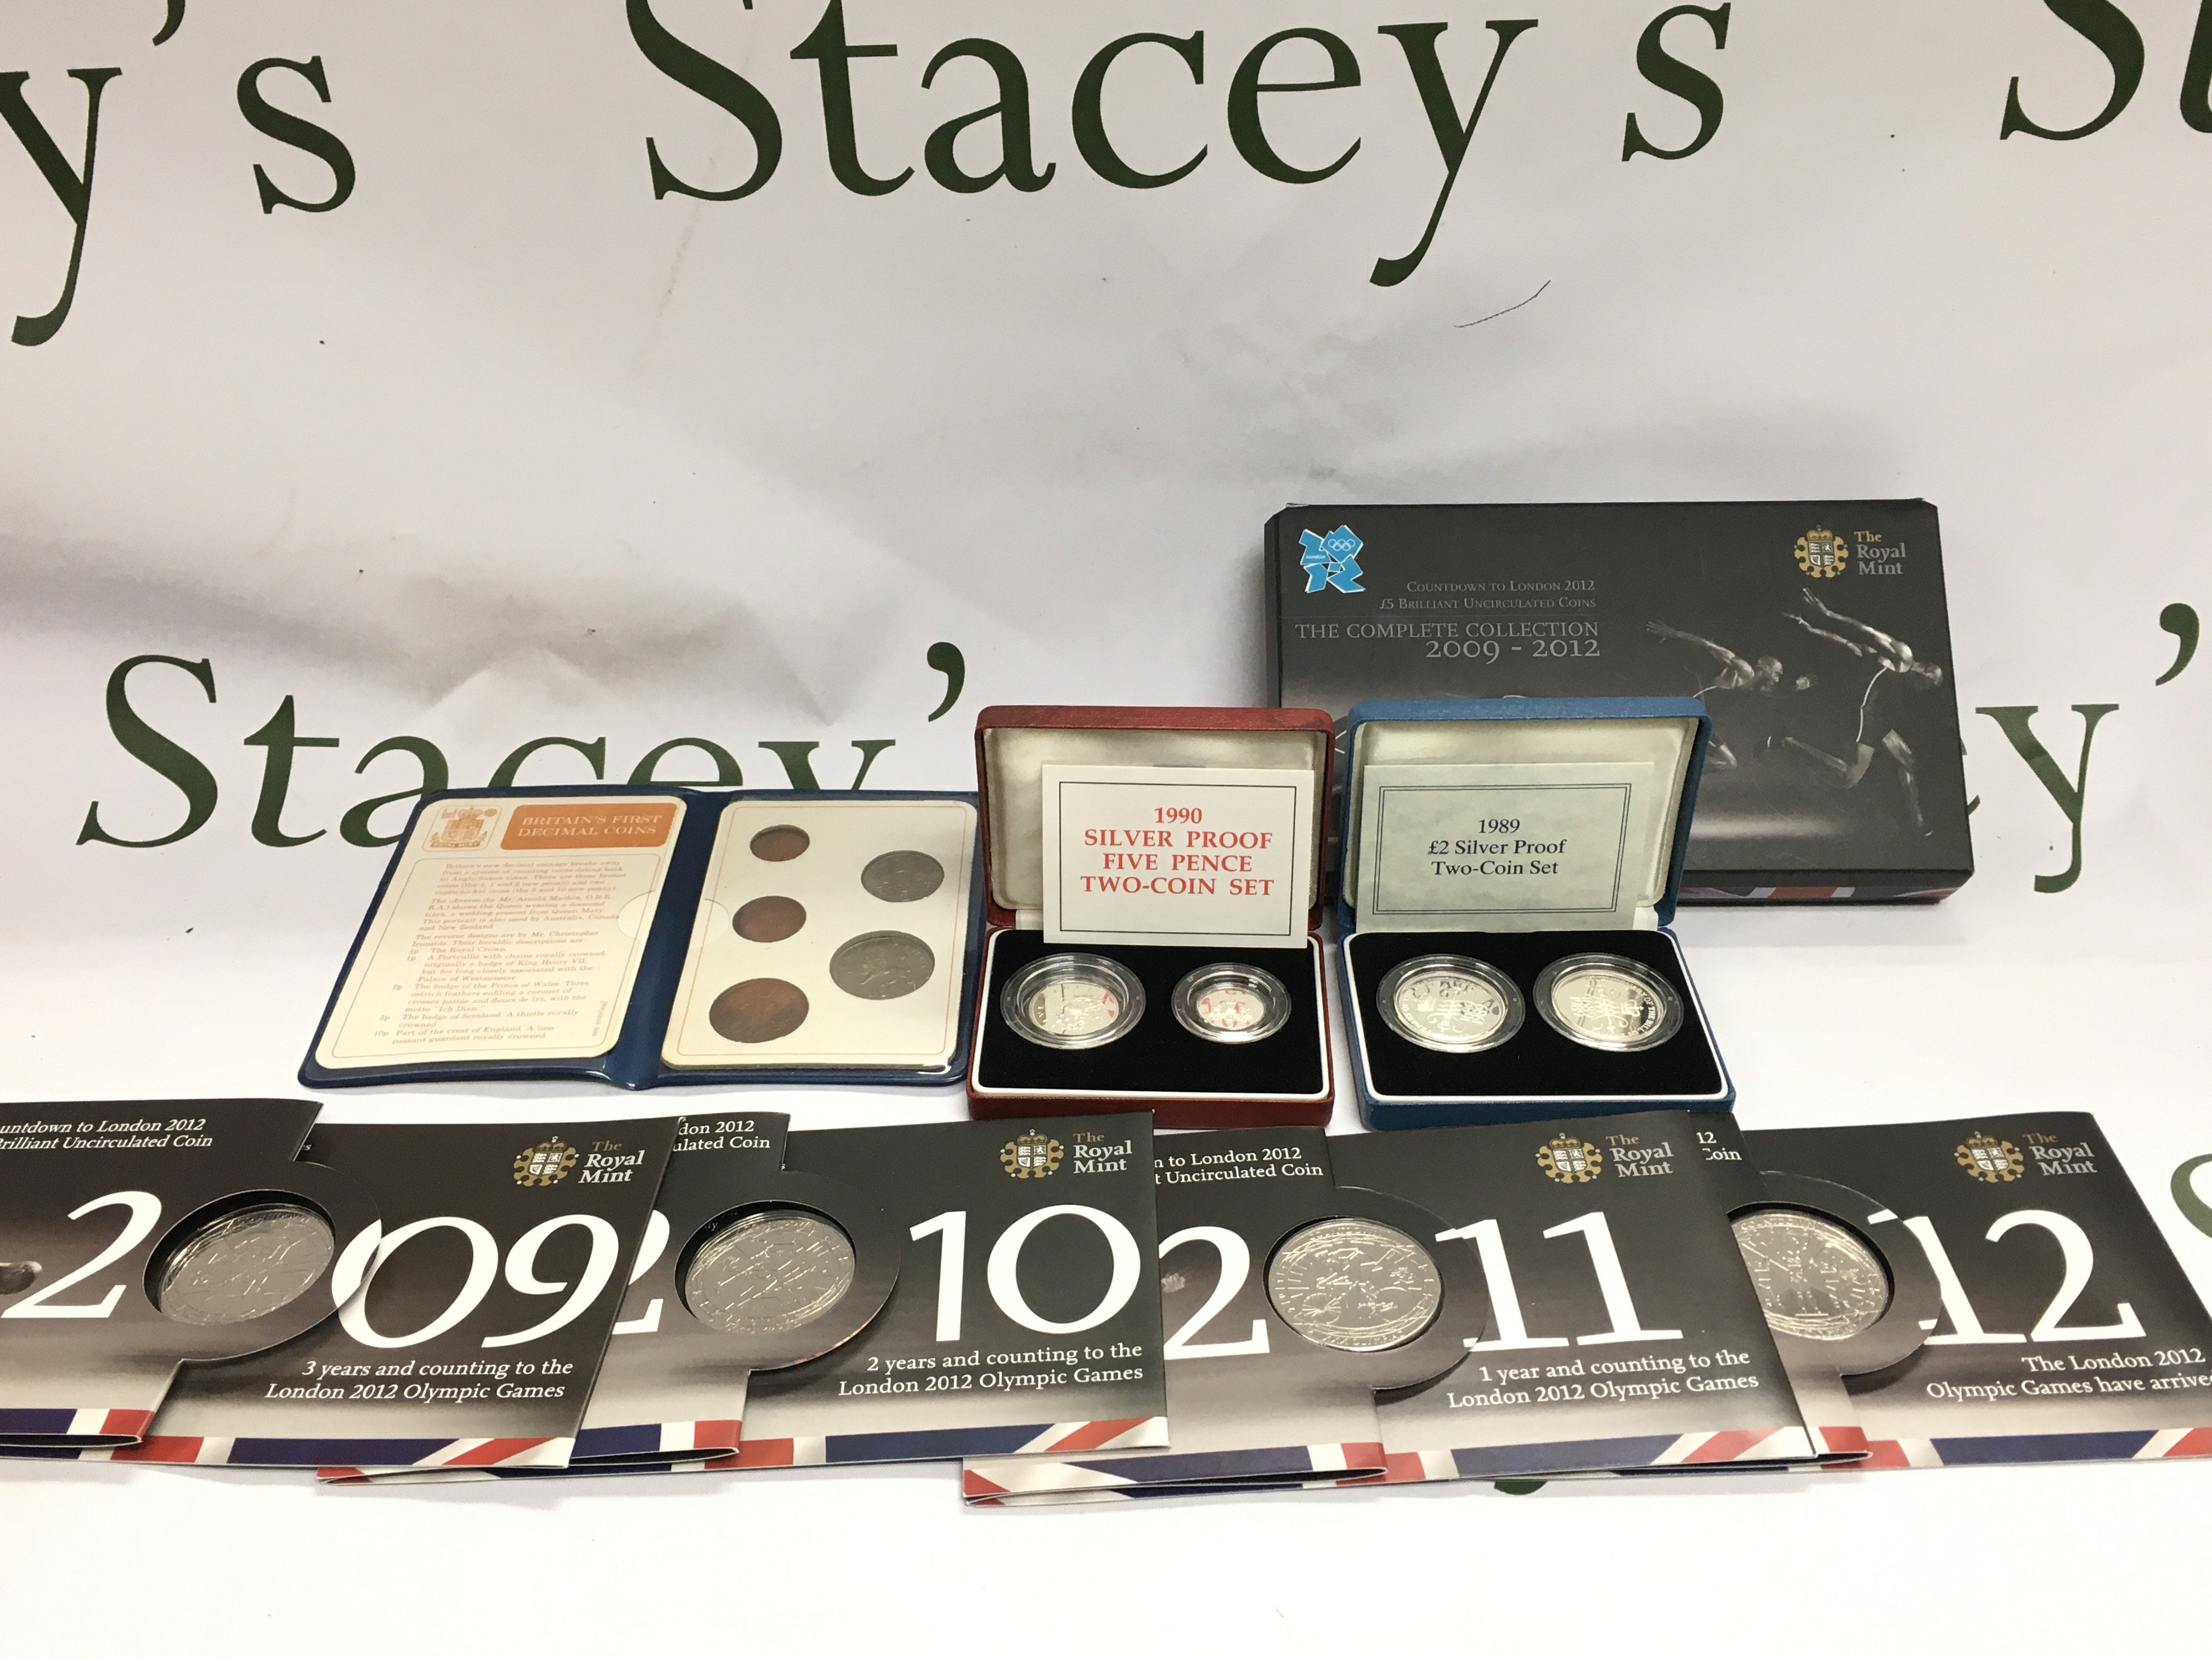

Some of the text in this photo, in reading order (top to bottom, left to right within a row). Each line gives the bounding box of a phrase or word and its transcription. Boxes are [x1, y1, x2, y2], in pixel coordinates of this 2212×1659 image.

[1854, 531, 1881, 541] The
[1856, 543, 1906, 562] Royal
[1858, 561, 1903, 574] Mint
[1407, 582, 1485, 592] Countdown
[1510, 580, 1560, 591] London
[1565, 580, 1594, 590] 2012
[1380, 597, 1596, 609] £5 Brilliant Uncirculated Coins
[1295, 622, 1598, 638] THE COMPLETE COLLECTION
[1426, 641, 1499, 664] 2009
[1533, 640, 1600, 657] 2012
[522, 816, 606, 825] BRITAIN'S
[1155, 808, 1202, 823] 1990
[518, 827, 598, 836] DECIMAL
[1479, 819, 1520, 833] 1989
[1085, 829, 1272, 849] SILVER PROOF
[1428, 839, 1567, 854] £2 Silver Proof
[1103, 853, 1251, 872] FIVE PENCE
[1431, 860, 1558, 875] Two-Coin Set
[1081, 876, 1274, 895] TWO-COIN SET
[0, 1119, 206, 1133] untdown to London 2012
[715, 1119, 756, 1133] 2012
[63, 1135, 171, 1148] Uncirculated
[173, 1135, 212, 1147] Coin
[593, 1141, 622, 1151] The
[729, 1136, 772, 1149] Coin
[1074, 1132, 1104, 1142] The
[1606, 1135, 1639, 1146] The
[2023, 1133, 2057, 1143] The
[1073, 1140, 1132, 1161] Royal
[1167, 1154, 1187, 1167] to
[1191, 1149, 1259, 1166] London
[1262, 1147, 1303, 1162] 2012
[1609, 1142, 1674, 1164] Royal
[2029, 1142, 2095, 1163] Royal
[584, 1150, 645, 1171] Royal
[1074, 1159, 1127, 1173] Mint
[1615, 1162, 1673, 1177] Mint
[2038, 1161, 2097, 1176] Mint
[578, 1170, 633, 1183] Mint
[1166, 1165, 1278, 1184] Uncirculated
[1282, 1163, 1324, 1177] Coin
[1, 1190, 162, 1318] 2
[331, 1214, 619, 1348] 09
[909, 1204, 1141, 1342] 10
[1435, 1211, 1684, 1353] 11
[1158, 1226, 1270, 1360] 2
[867, 1342, 1142, 1375] 2 years and counting to the
[1479, 1350, 1750, 1385] 1 year and counting to the
[2021, 1348, 2206, 1372] The London 2012
[302, 1359, 573, 1380] 3 years and counting to the
[838, 1368, 1143, 1395] London 2012 Olympic Games
[1926, 1369, 2212, 1403] Olympic Games have arrive
[264, 1383, 565, 1403] London 2012 Olympic Games
[1447, 1376, 1759, 1408] London 2012 Olympic Games
